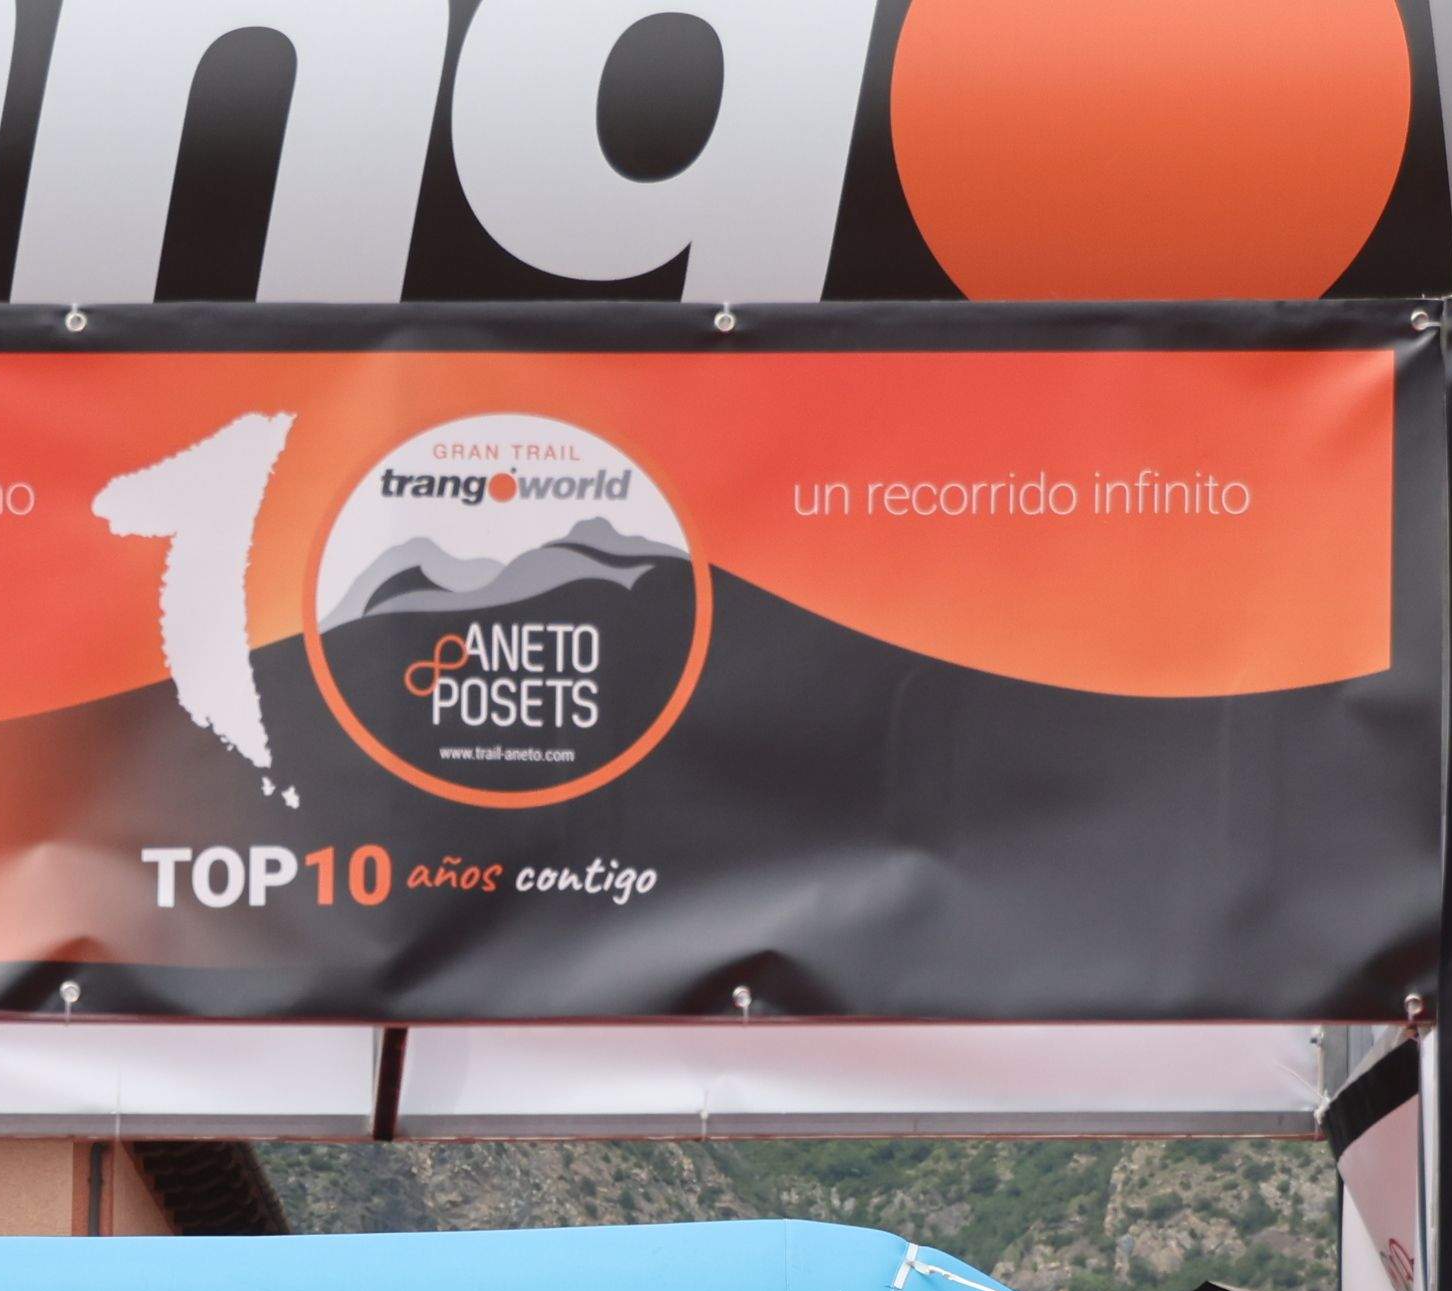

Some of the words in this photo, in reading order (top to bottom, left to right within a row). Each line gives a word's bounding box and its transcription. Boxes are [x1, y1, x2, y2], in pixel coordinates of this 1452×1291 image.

[433, 443, 501, 461] GRAN
[511, 443, 580, 461] TRAIL
[793, 479, 853, 517] un
[866, 472, 1078, 517] recorrido
[1092, 470, 1251, 516] infinito
[463, 623, 600, 674] ANETO
[432, 679, 600, 729] POSETS
[439, 745, 575, 762] www.trail-aneto.com
[406, 856, 501, 891] años
[515, 854, 657, 904] contigo
